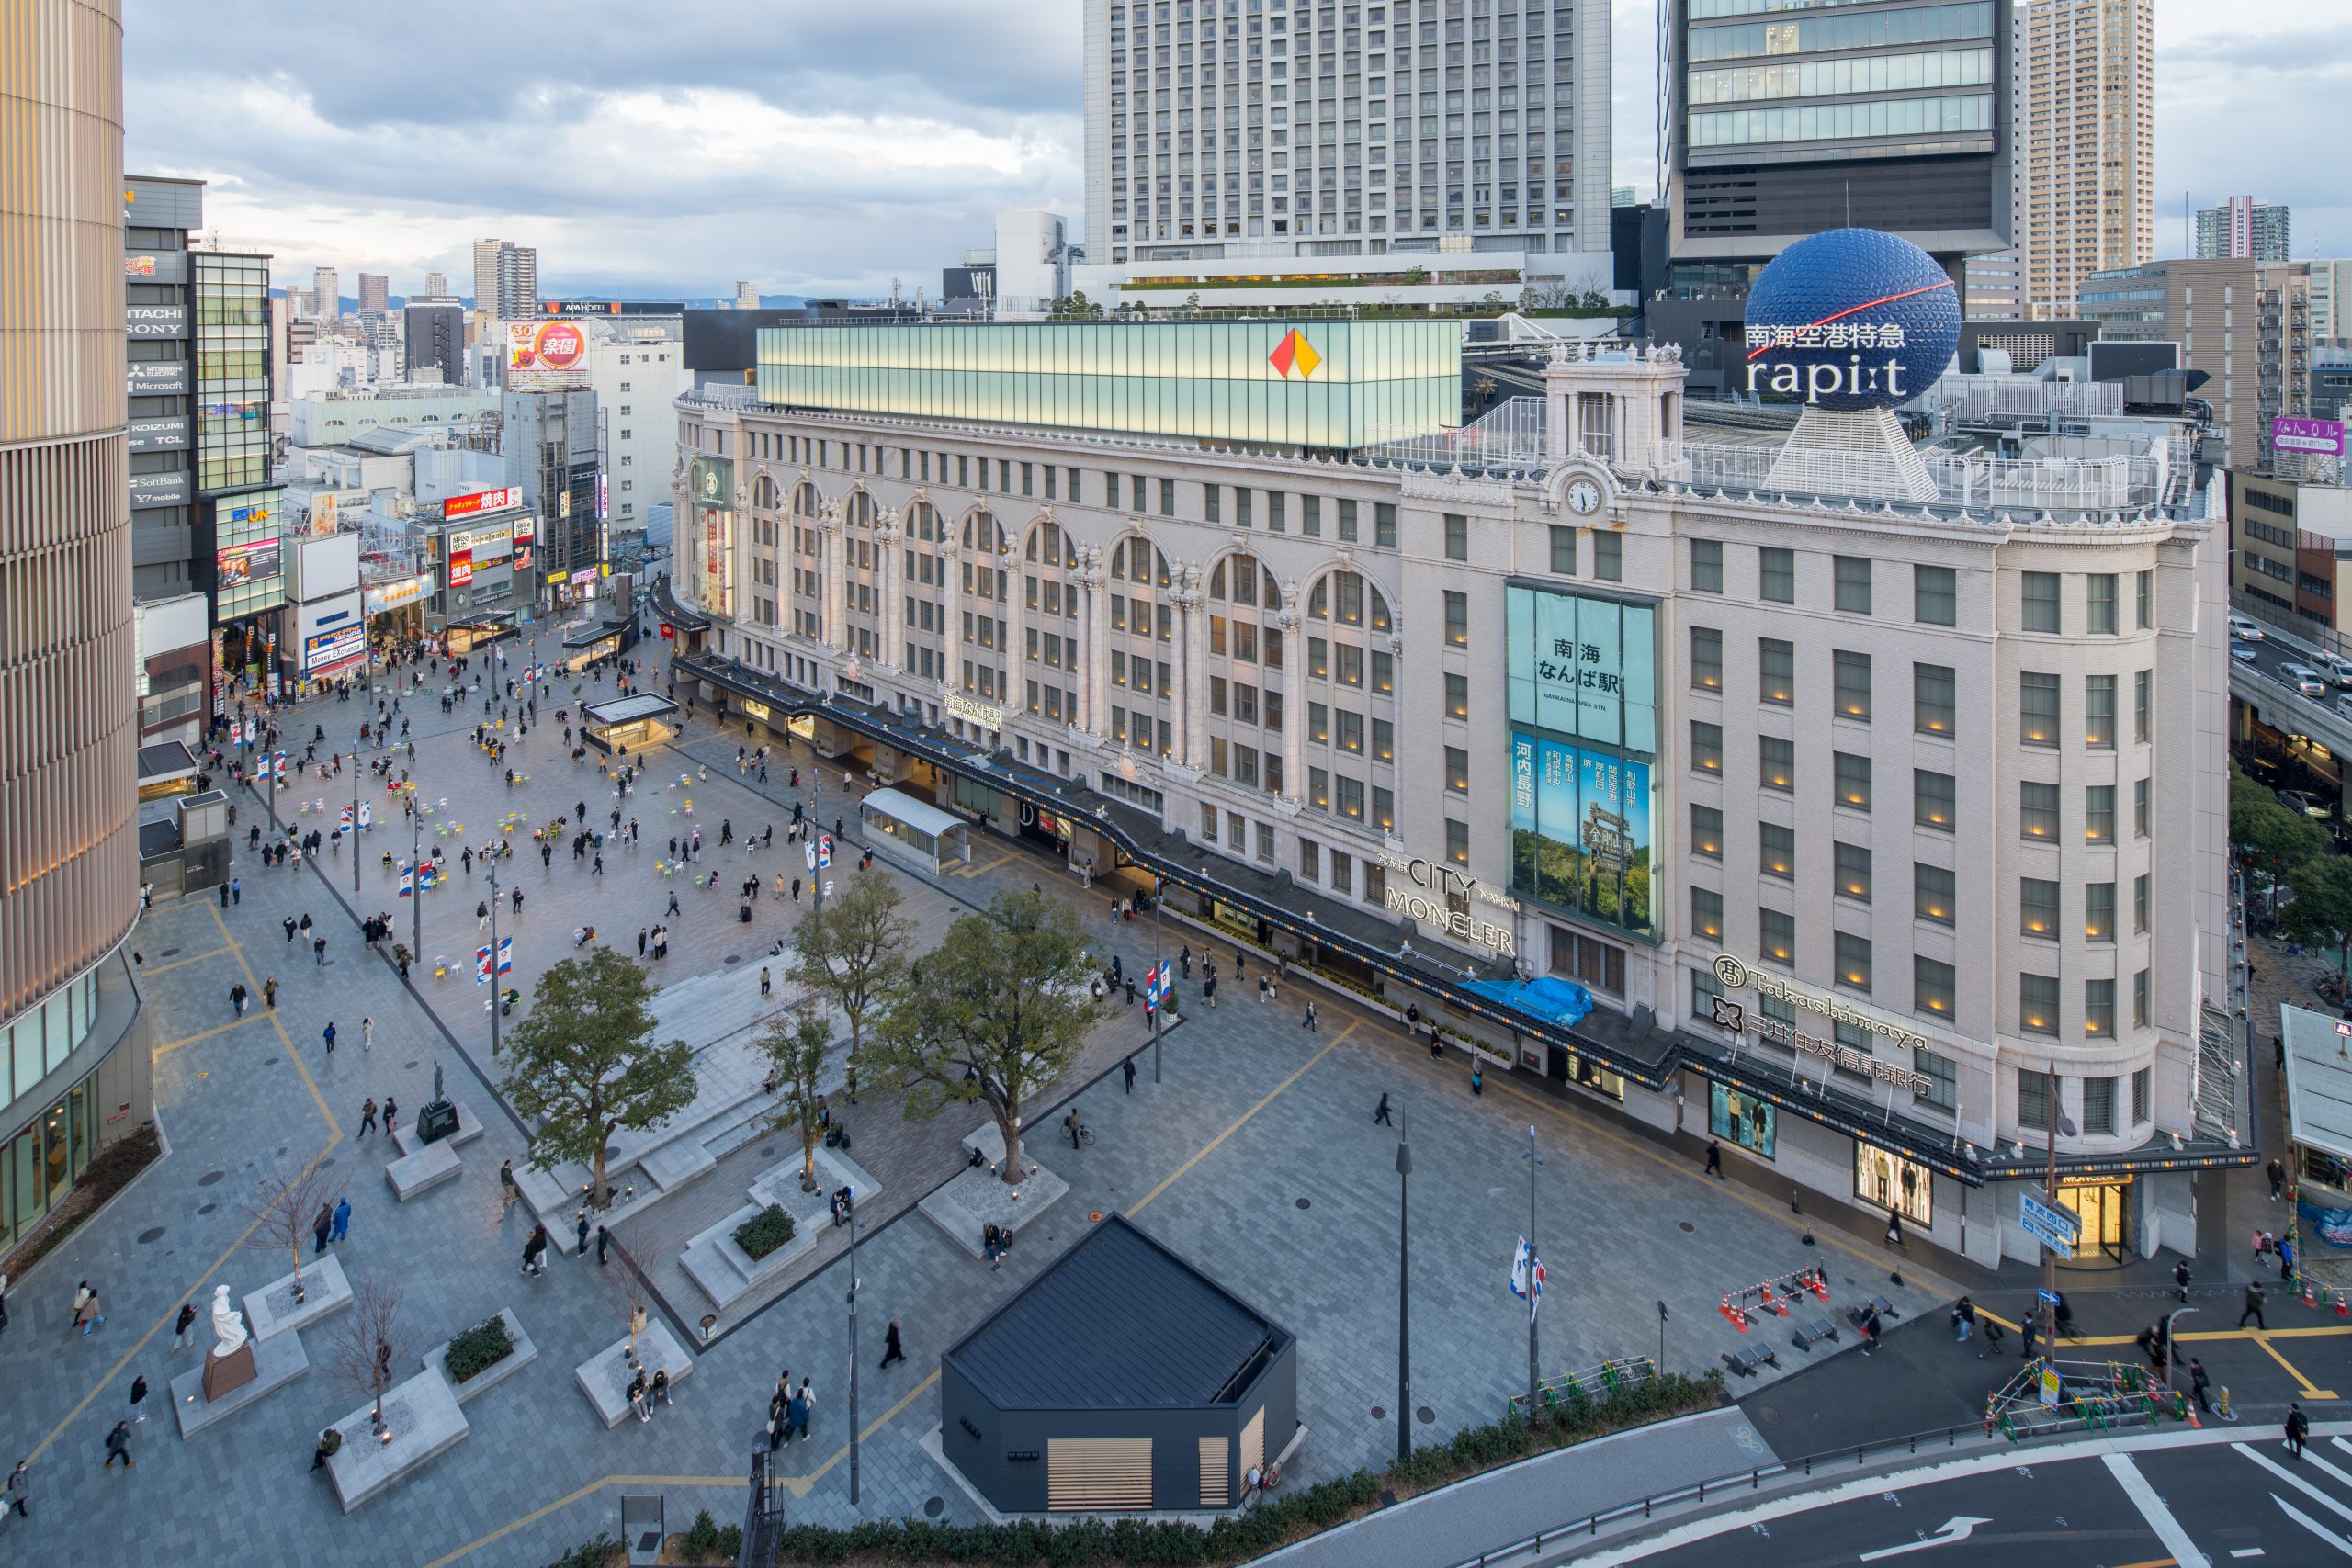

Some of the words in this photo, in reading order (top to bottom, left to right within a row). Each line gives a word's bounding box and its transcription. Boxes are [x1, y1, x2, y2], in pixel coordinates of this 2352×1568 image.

[127, 309, 183, 319] ITACHI
[126, 324, 182, 334] SONY
[1745, 323, 1906, 349] 南海空港特急
[543, 337, 578, 355] 楽園
[136, 381, 184, 390] Microsoft
[131, 423, 184, 432] KOIZUMI
[154, 435, 185, 445] TCL
[140, 476, 185, 488] SoftBank
[481, 491, 505, 509] 焼肉
[232, 507, 269, 523] EDION
[241, 525, 263, 533] NAMBA
[451, 563, 471, 579] 焼肉
[580, 569, 596, 581] ジャンカラ
[475, 595, 498, 605] STARBUCKS
[311, 654, 331, 665] Money
[333, 644, 360, 658] EXchange
[1554, 638, 1600, 664] 南海
[1539, 660, 1619, 694] なんば駅
[944, 692, 1001, 727] 南海なんば駅
[1544, 693, 1566, 702] NANKAI
[1566, 697, 1592, 708] NAMBA
[948, 707, 967, 721] NANKAI
[967, 714, 987, 728] NAMBA
[1552, 750, 1562, 788] 和泉中央
[1564, 753, 1574, 783] 高野山
[1582, 758, 1592, 769] 堺
[1516, 741, 1532, 809] 河内長野
[1595, 761, 1605, 791] 岸和田
[1608, 764, 1618, 804] 関西空港
[1626, 771, 1636, 809] 和歌山市
[1377, 852, 1408, 874] なんば
[1408, 857, 1478, 903] CITY
[1479, 888, 1520, 913] NANKAI
[1385, 886, 1516, 957] MONCLER
[1748, 969, 1929, 1052] Takashimaya
[1748, 1012, 1933, 1097] 三井住友信託銀行
[2024, 1197, 2069, 1232] 難波西口
